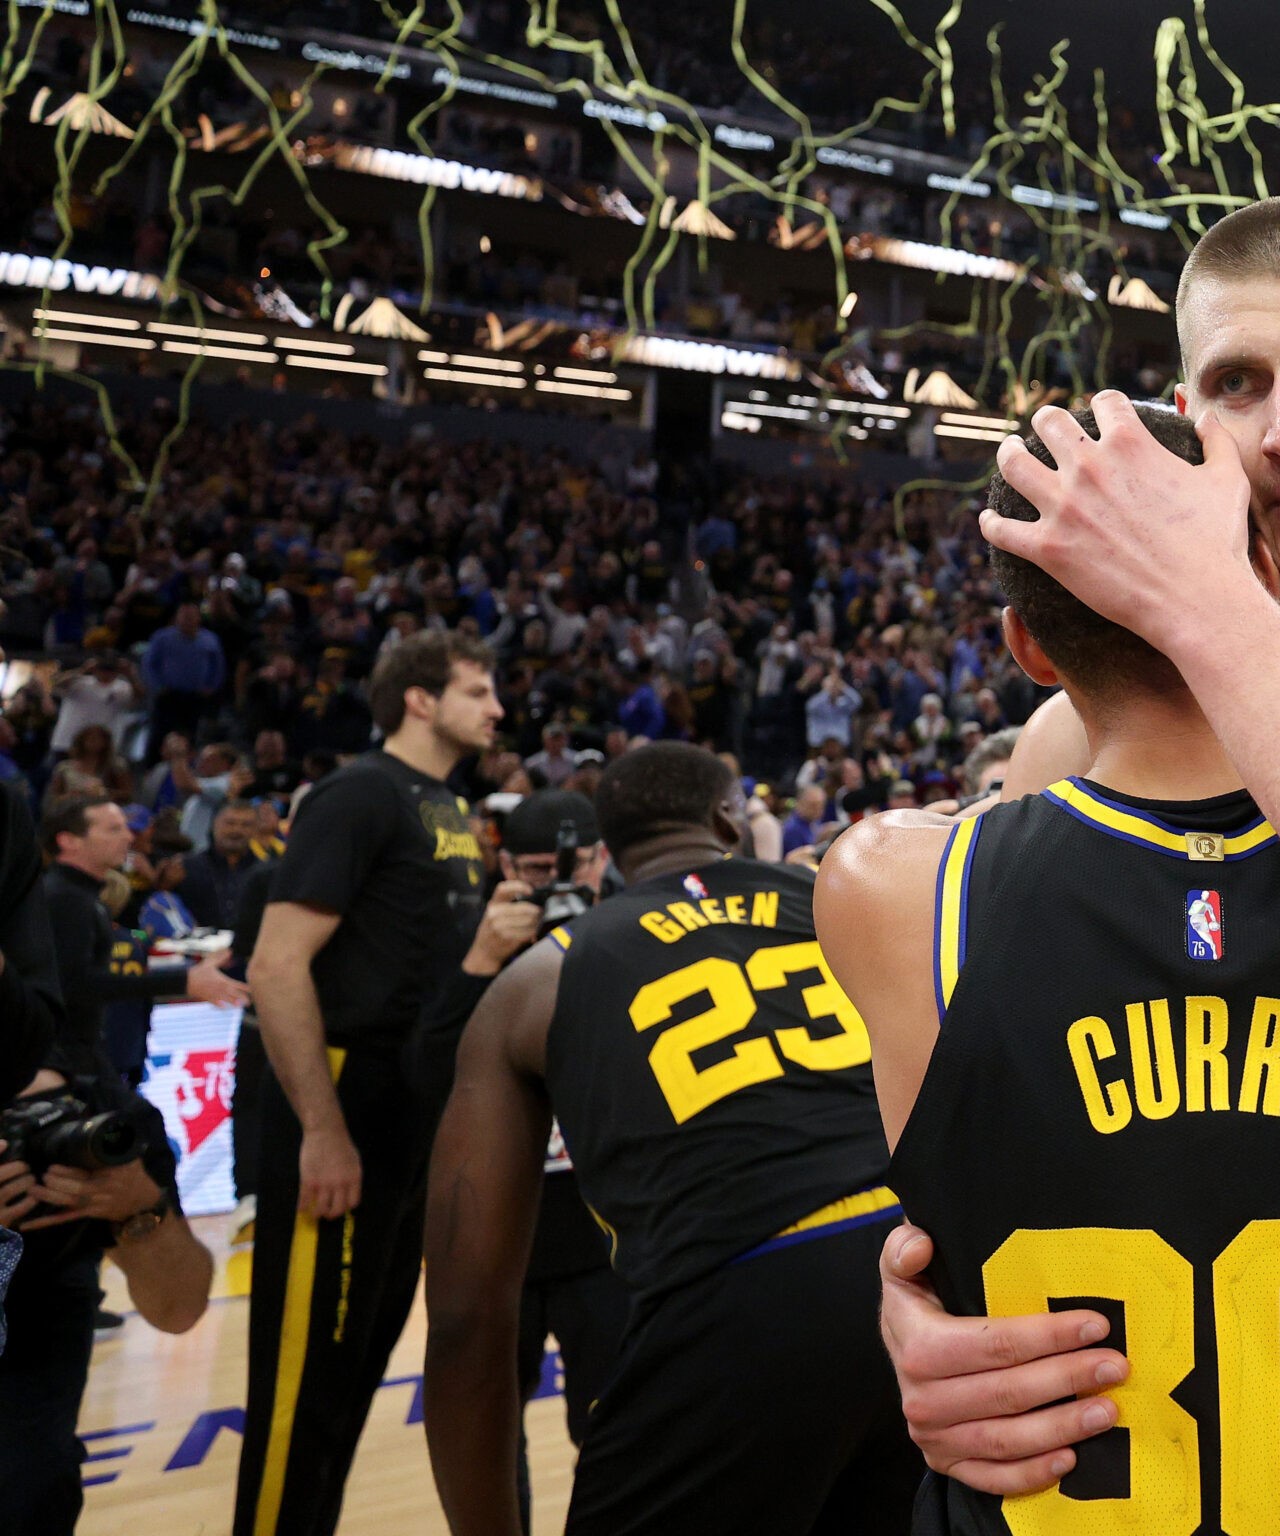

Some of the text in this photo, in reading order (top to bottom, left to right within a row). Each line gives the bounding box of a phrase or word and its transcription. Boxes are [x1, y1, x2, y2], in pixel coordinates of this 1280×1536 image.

[639, 891, 780, 945] GREEN
[1192, 940, 1206, 957] 75
[628, 940, 873, 1126] 23
